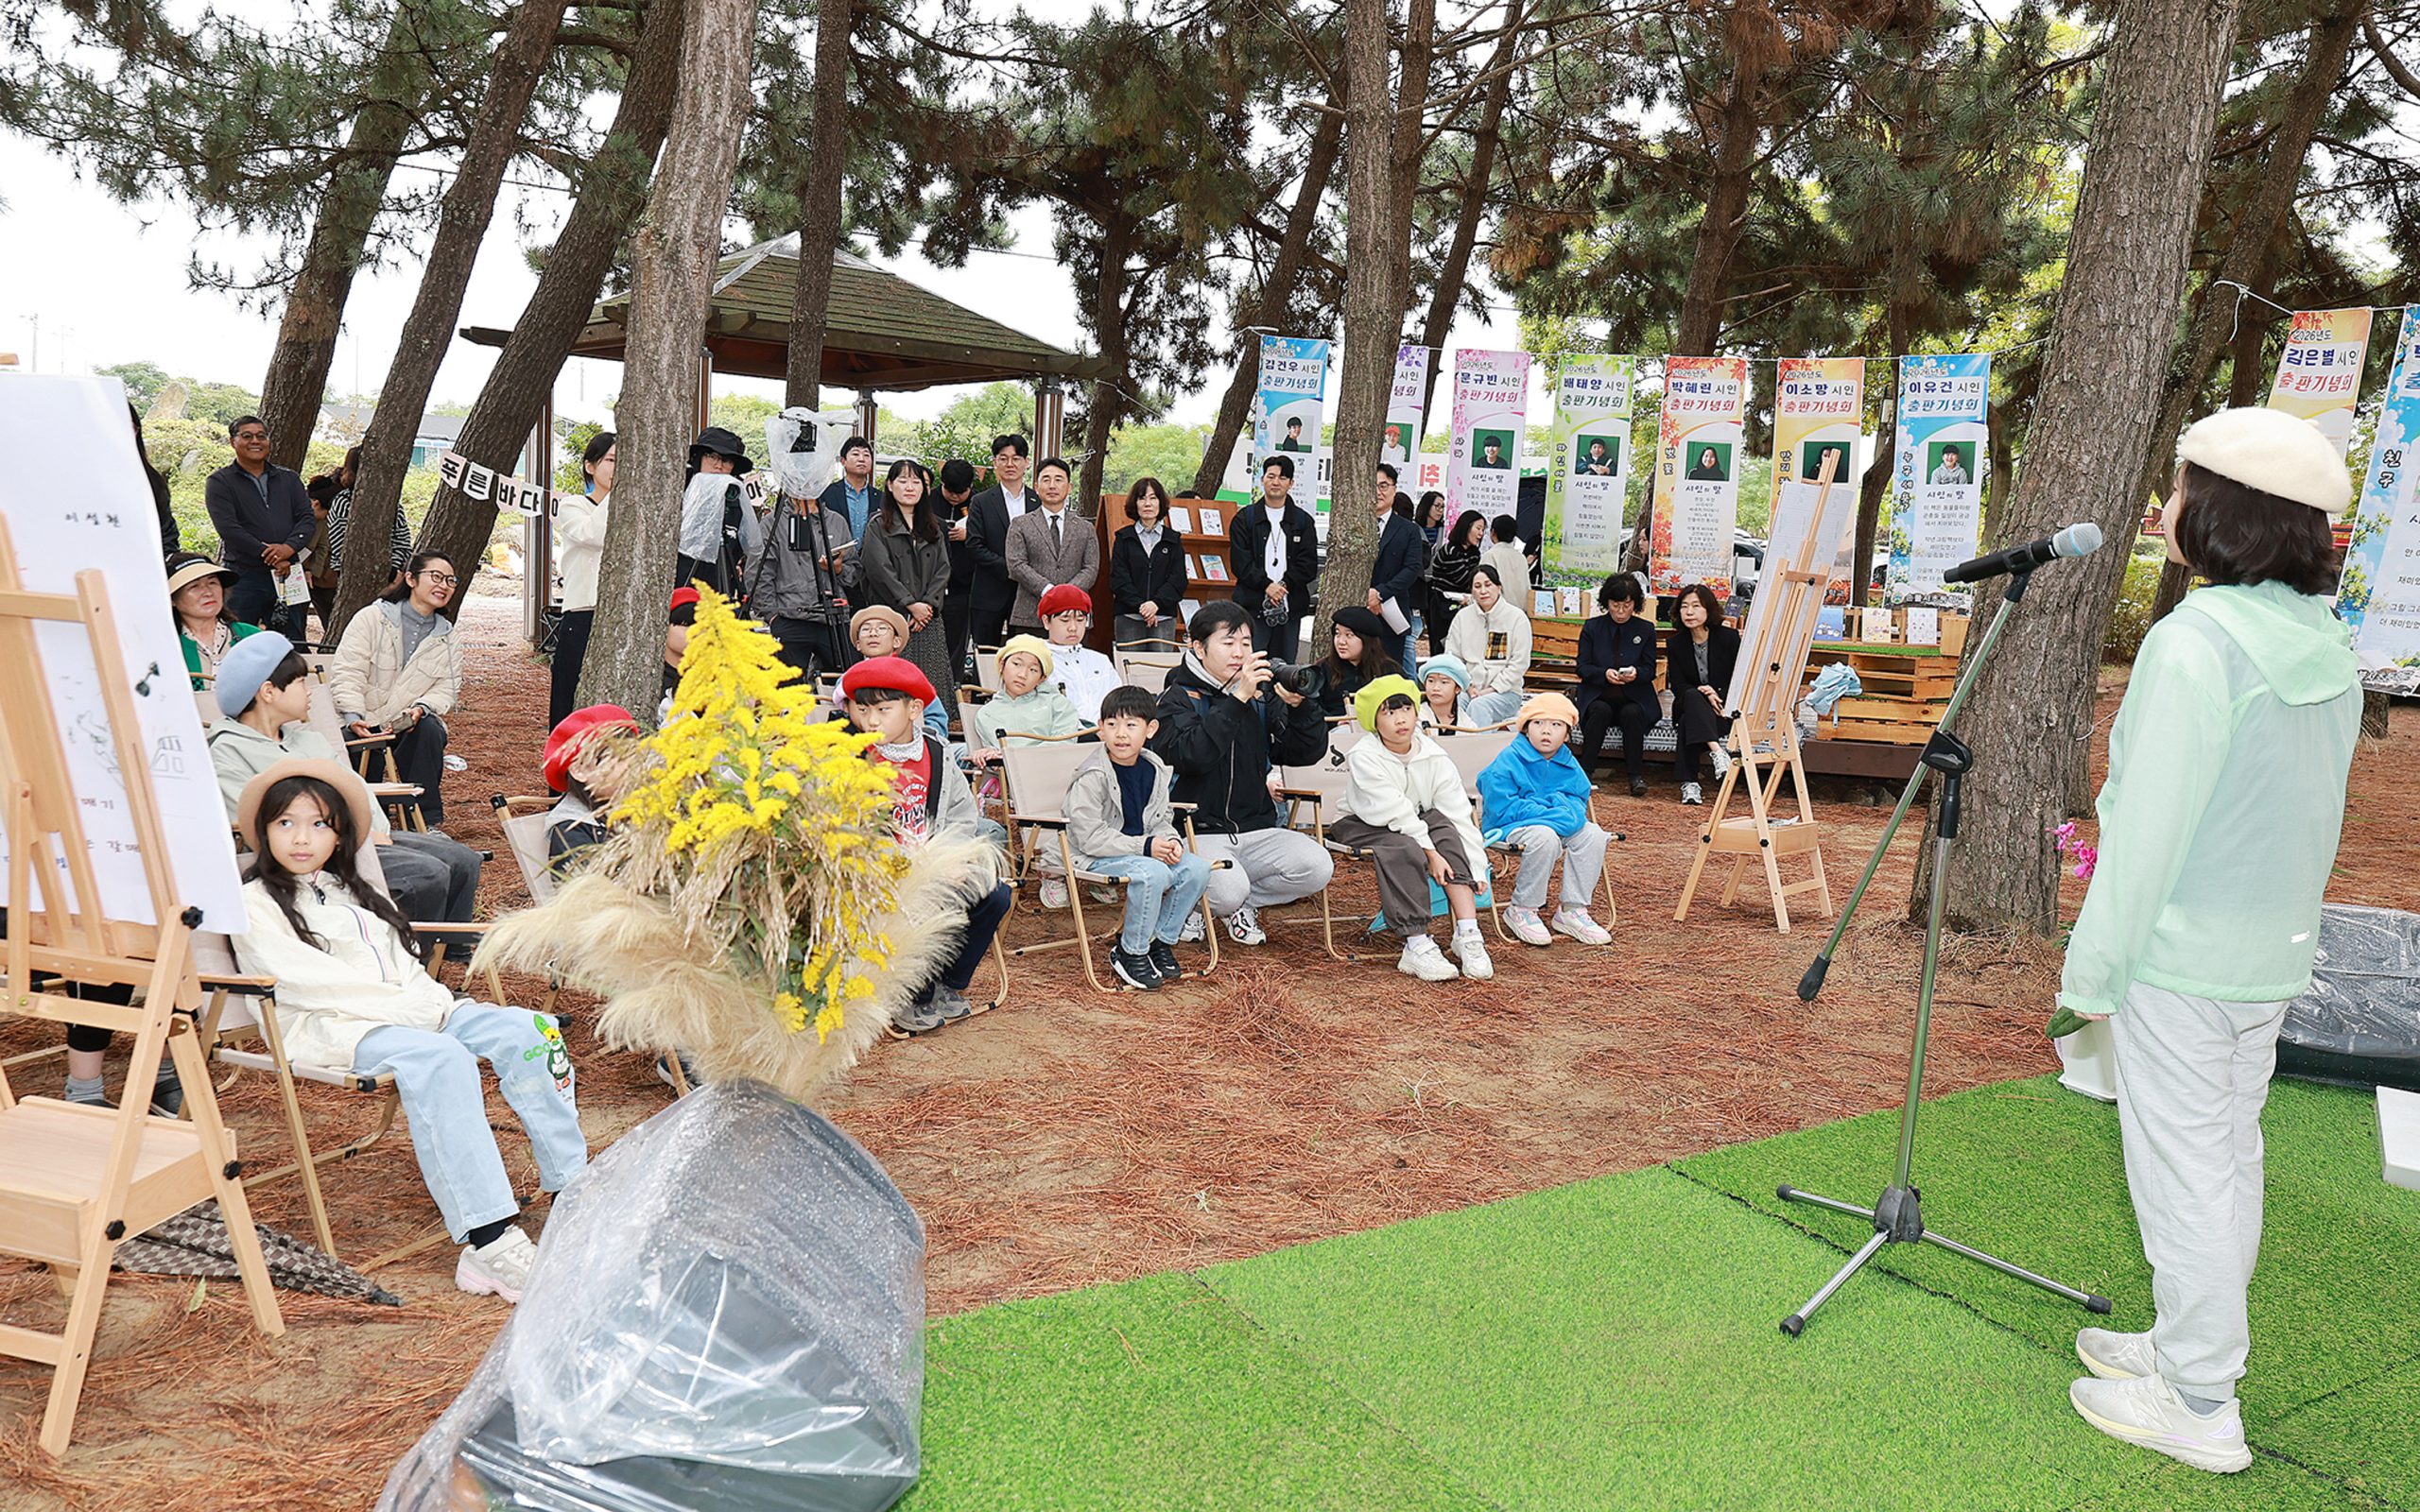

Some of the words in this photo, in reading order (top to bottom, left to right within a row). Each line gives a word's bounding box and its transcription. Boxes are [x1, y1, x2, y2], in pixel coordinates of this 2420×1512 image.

[2286, 348, 2335, 367] 김은별
[2336, 350, 2360, 367] 시인
[1265, 359, 1298, 372] 김건우
[1301, 364, 1320, 374] 시인
[1398, 371, 1419, 382] 시인
[1461, 372, 1497, 386] 문규빈
[1501, 377, 1521, 387] 시인
[1787, 370, 1823, 379] 2026년도
[1264, 375, 1318, 389] 출판기념회
[1564, 377, 1602, 390] 배태양
[1604, 381, 1626, 392] 시인
[1671, 382, 1712, 394] 박혜린
[1715, 385, 1737, 395] 시인
[1910, 381, 1953, 394] 이유건
[1957, 382, 1980, 393] 시인
[2279, 371, 2355, 393] 출판기념회
[1459, 388, 1518, 403] 출판기념회
[1786, 384, 1829, 396] 이소망
[1832, 386, 1854, 396] 시인
[1562, 394, 1624, 408] 출판기념회
[1670, 398, 1736, 411] 출판기념회
[1784, 401, 1853, 413] 출판기념회
[1908, 399, 1979, 412] 출판기념회
[2378, 449, 2402, 489] 친구
[2378, 618, 2388, 627] 더
